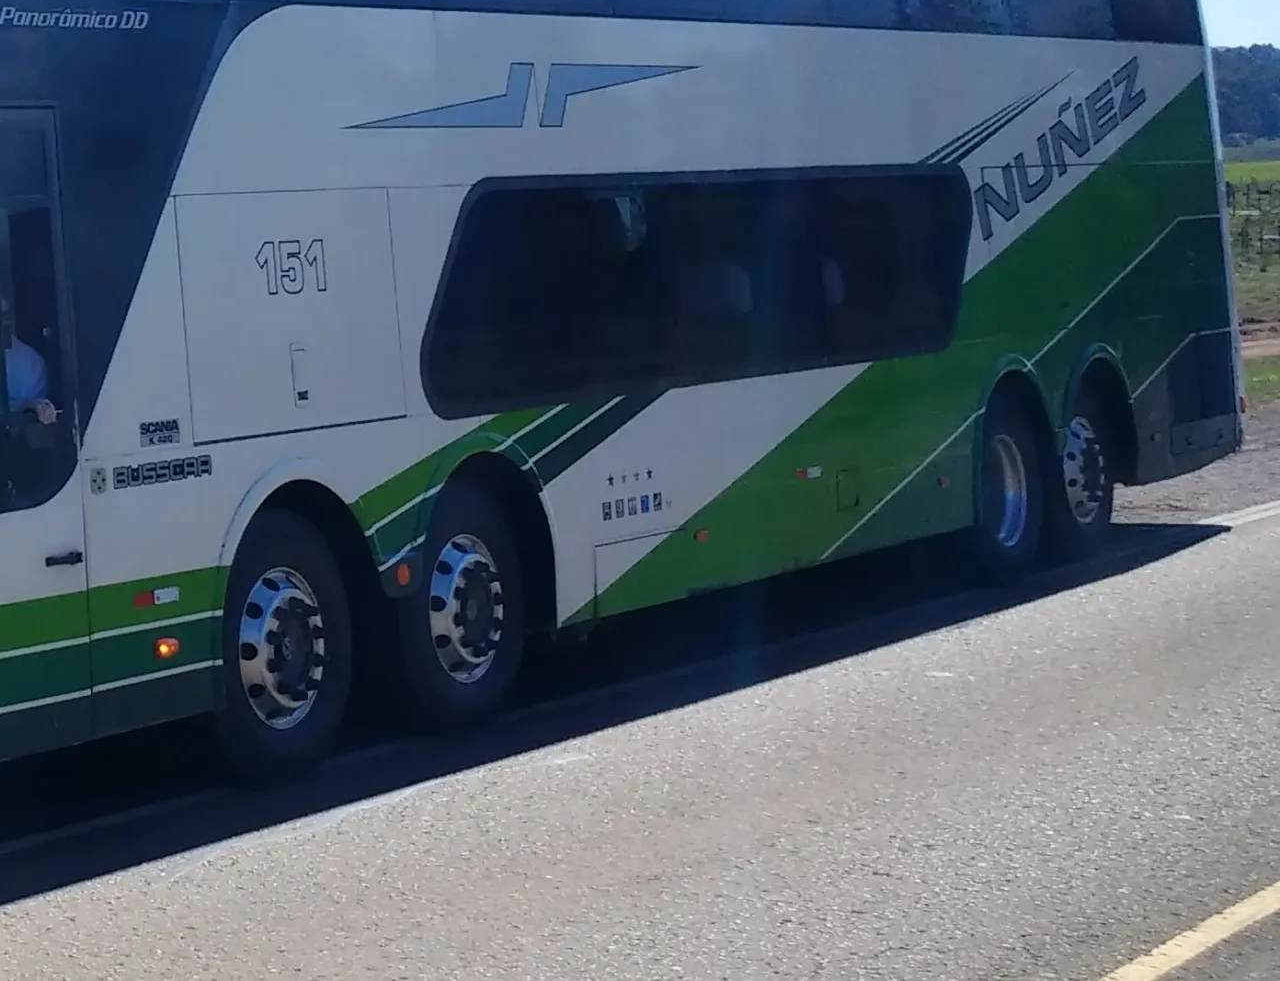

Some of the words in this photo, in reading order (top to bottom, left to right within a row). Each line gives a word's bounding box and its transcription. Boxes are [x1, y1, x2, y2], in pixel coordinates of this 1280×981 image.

[119, 10, 149, 30] DD
[974, 55, 1147, 242] NUÑEZ
[255, 238, 327, 296] 151
[140, 419, 179, 435] SCANIA
[113, 454, 212, 490] BUSSCAR
